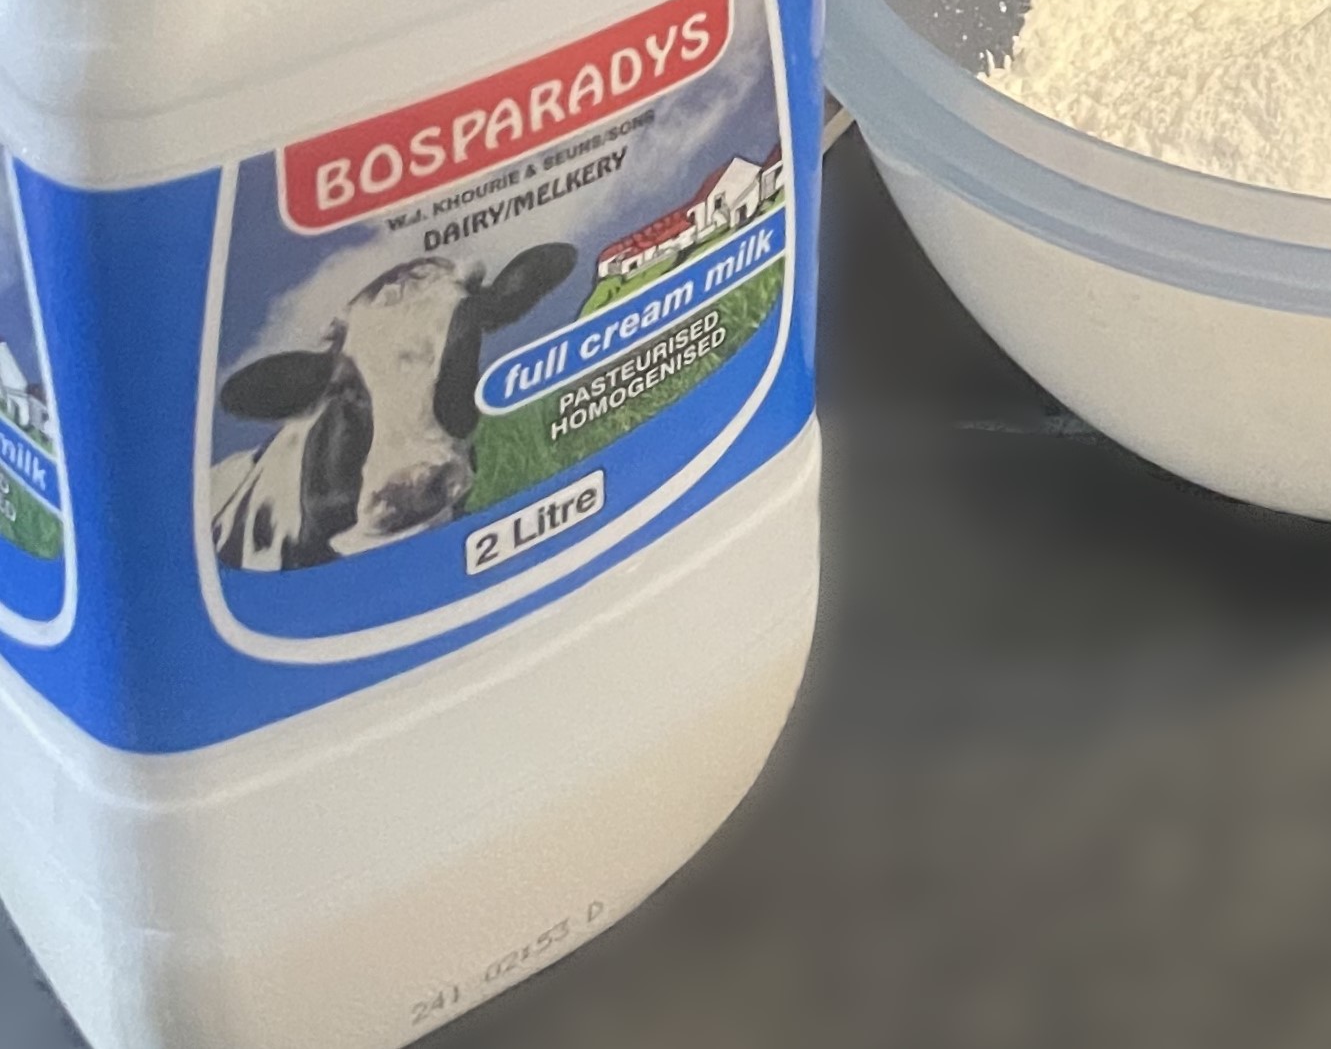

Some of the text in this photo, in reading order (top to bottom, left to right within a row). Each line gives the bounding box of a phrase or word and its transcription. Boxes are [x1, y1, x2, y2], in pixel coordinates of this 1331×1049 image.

[315, 11, 710, 212] BOSPARADYS
[424, 145, 628, 251] DAIRY/MELKERY
[433, 168, 521, 217] KHOURIE
[524, 163, 538, 180] &
[503, 226, 775, 398] full cream milk
[559, 310, 720, 414] PASTEURISED
[550, 327, 727, 441] HOMOGENISED
[475, 483, 597, 566] 2 Litre
